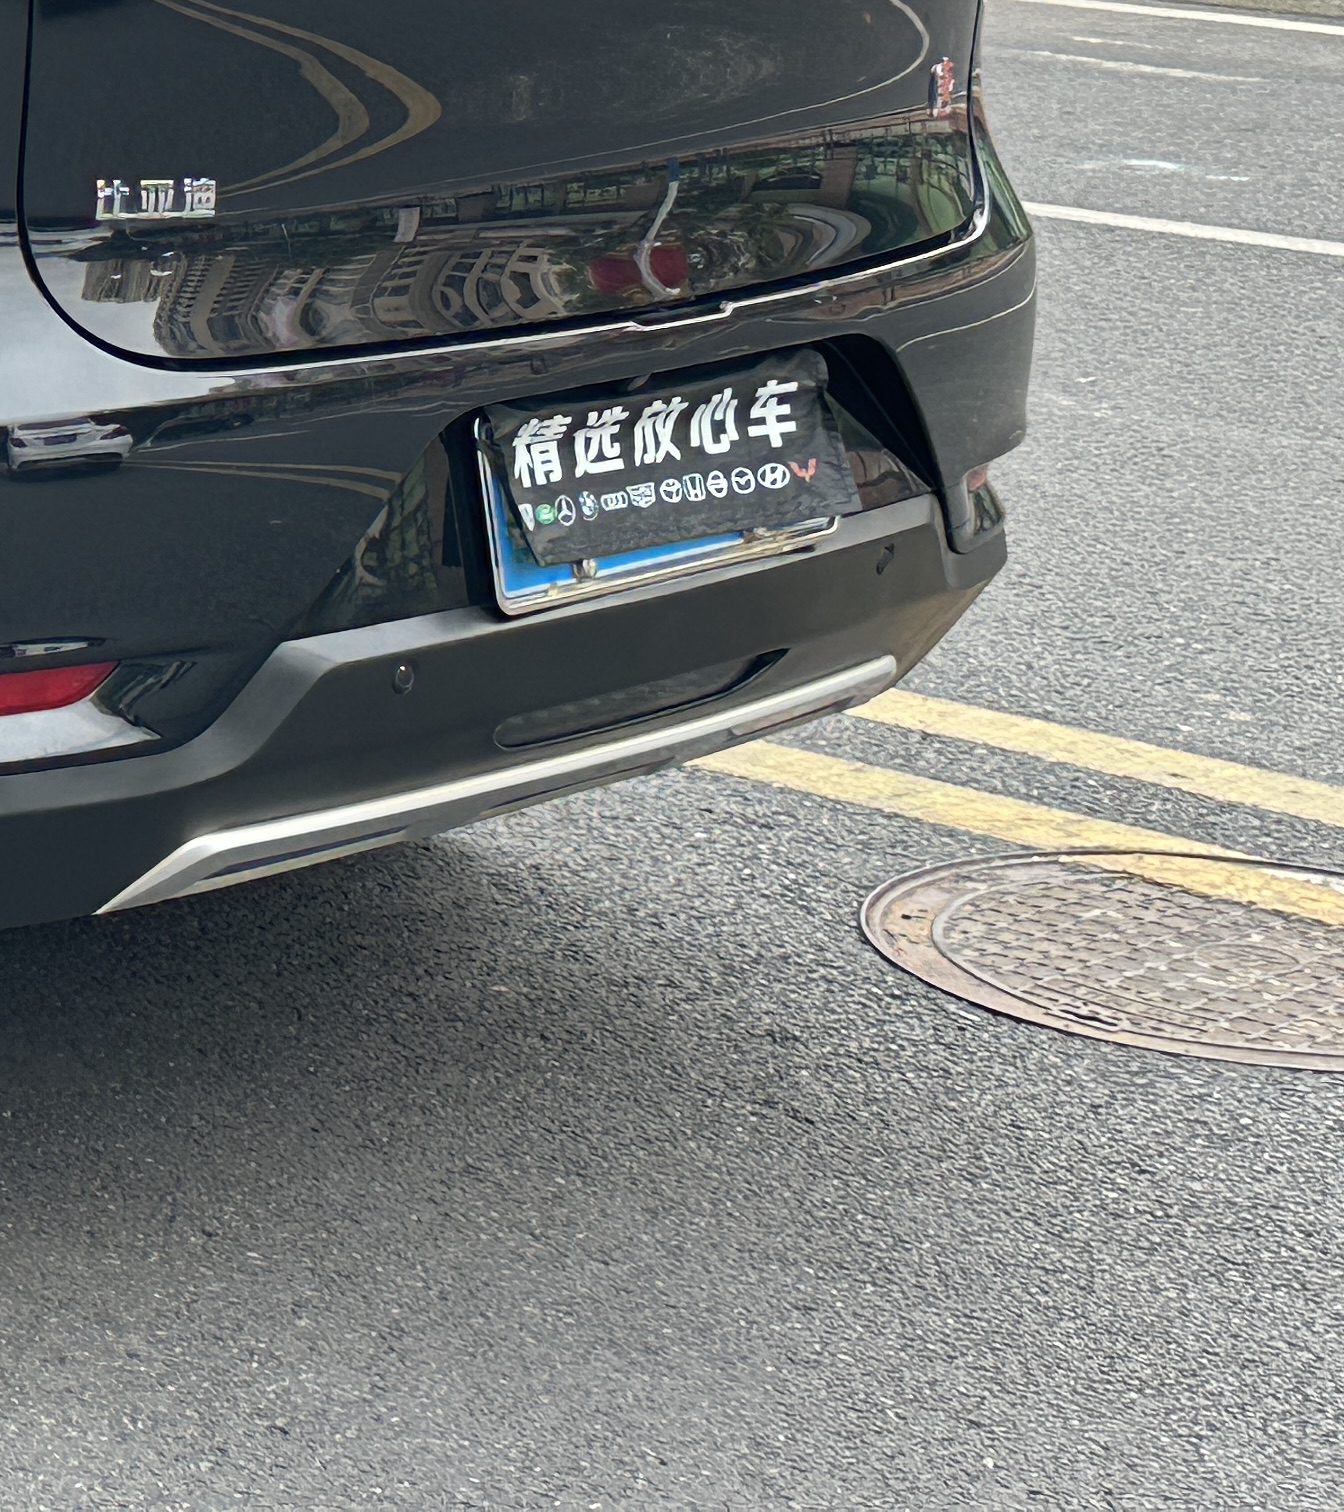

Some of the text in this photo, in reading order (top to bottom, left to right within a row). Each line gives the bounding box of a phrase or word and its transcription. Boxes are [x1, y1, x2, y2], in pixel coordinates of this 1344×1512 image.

[513, 379, 799, 488] 精选放心车
